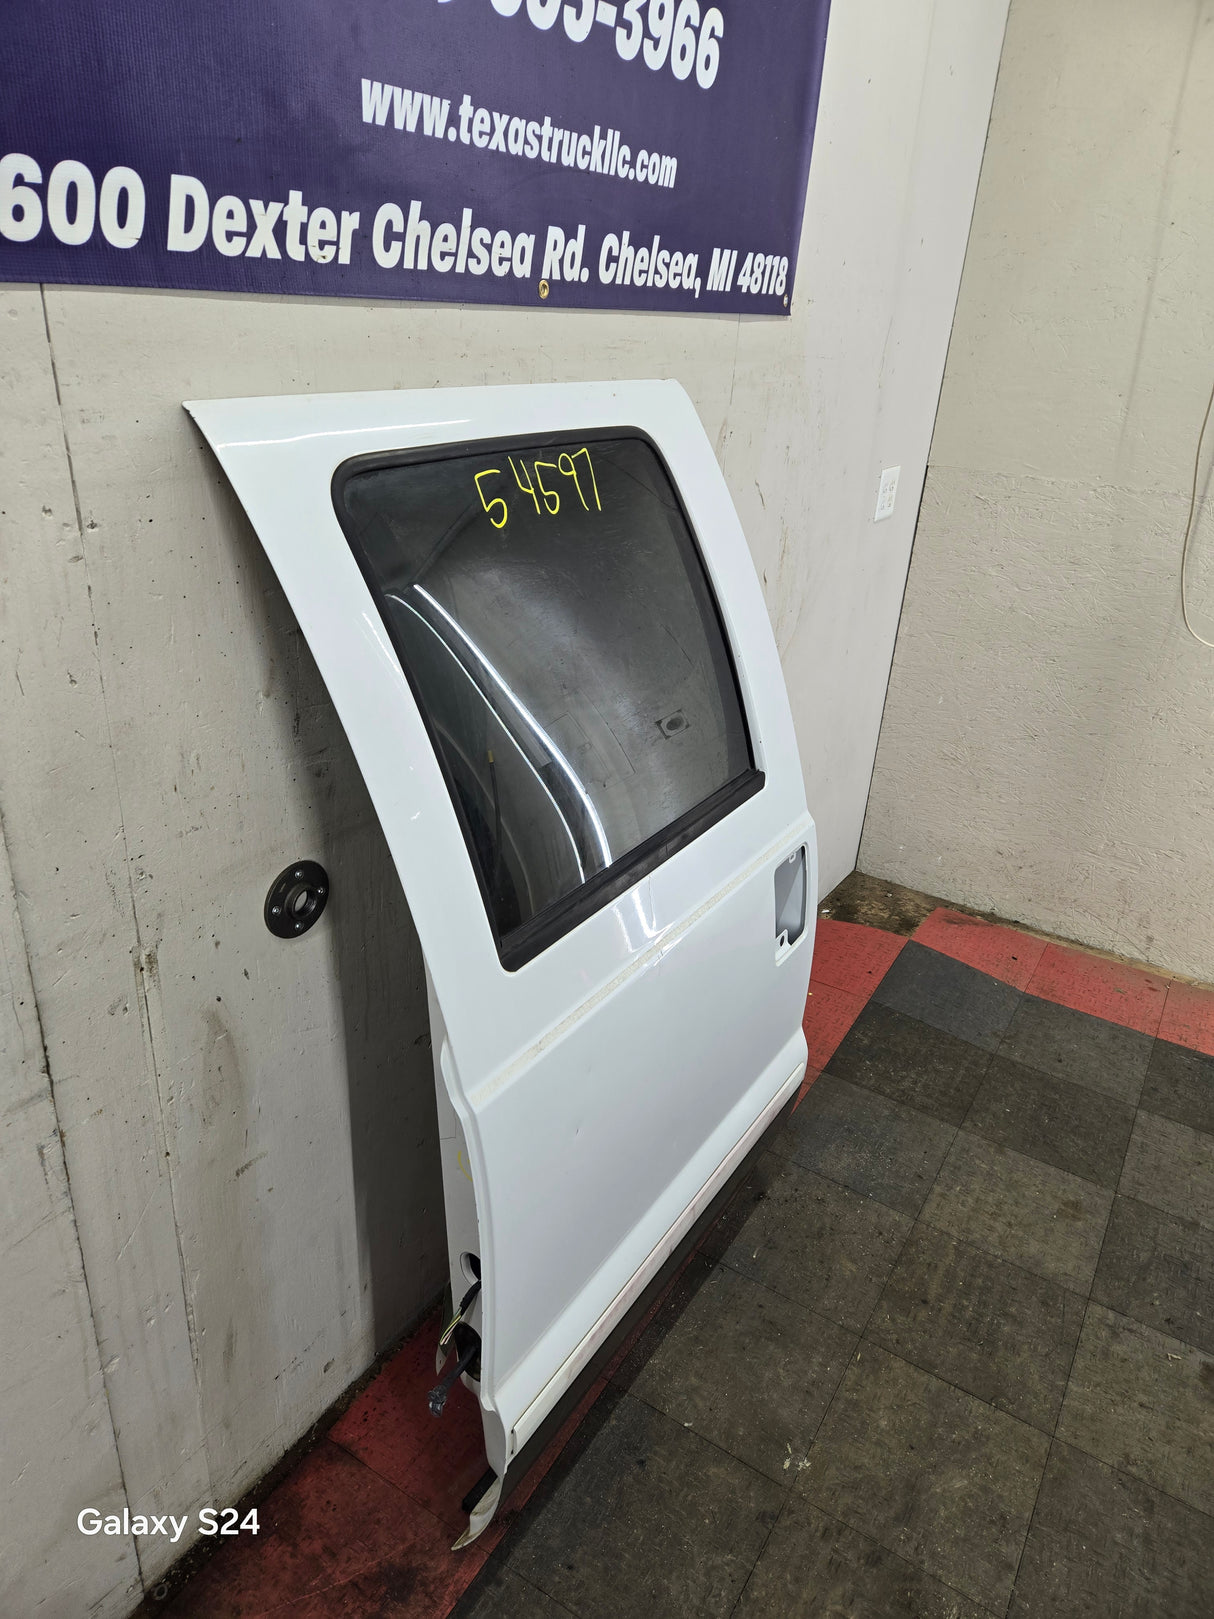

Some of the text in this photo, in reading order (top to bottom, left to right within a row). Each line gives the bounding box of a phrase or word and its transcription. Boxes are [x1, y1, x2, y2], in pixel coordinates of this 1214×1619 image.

[361, 77, 678, 189] www.texastruckllc.com
[0, 152, 790, 299] 600 Dexter Chelsea Rd. Chelsea, MI 48118
[474, 447, 602, 529] 54597
